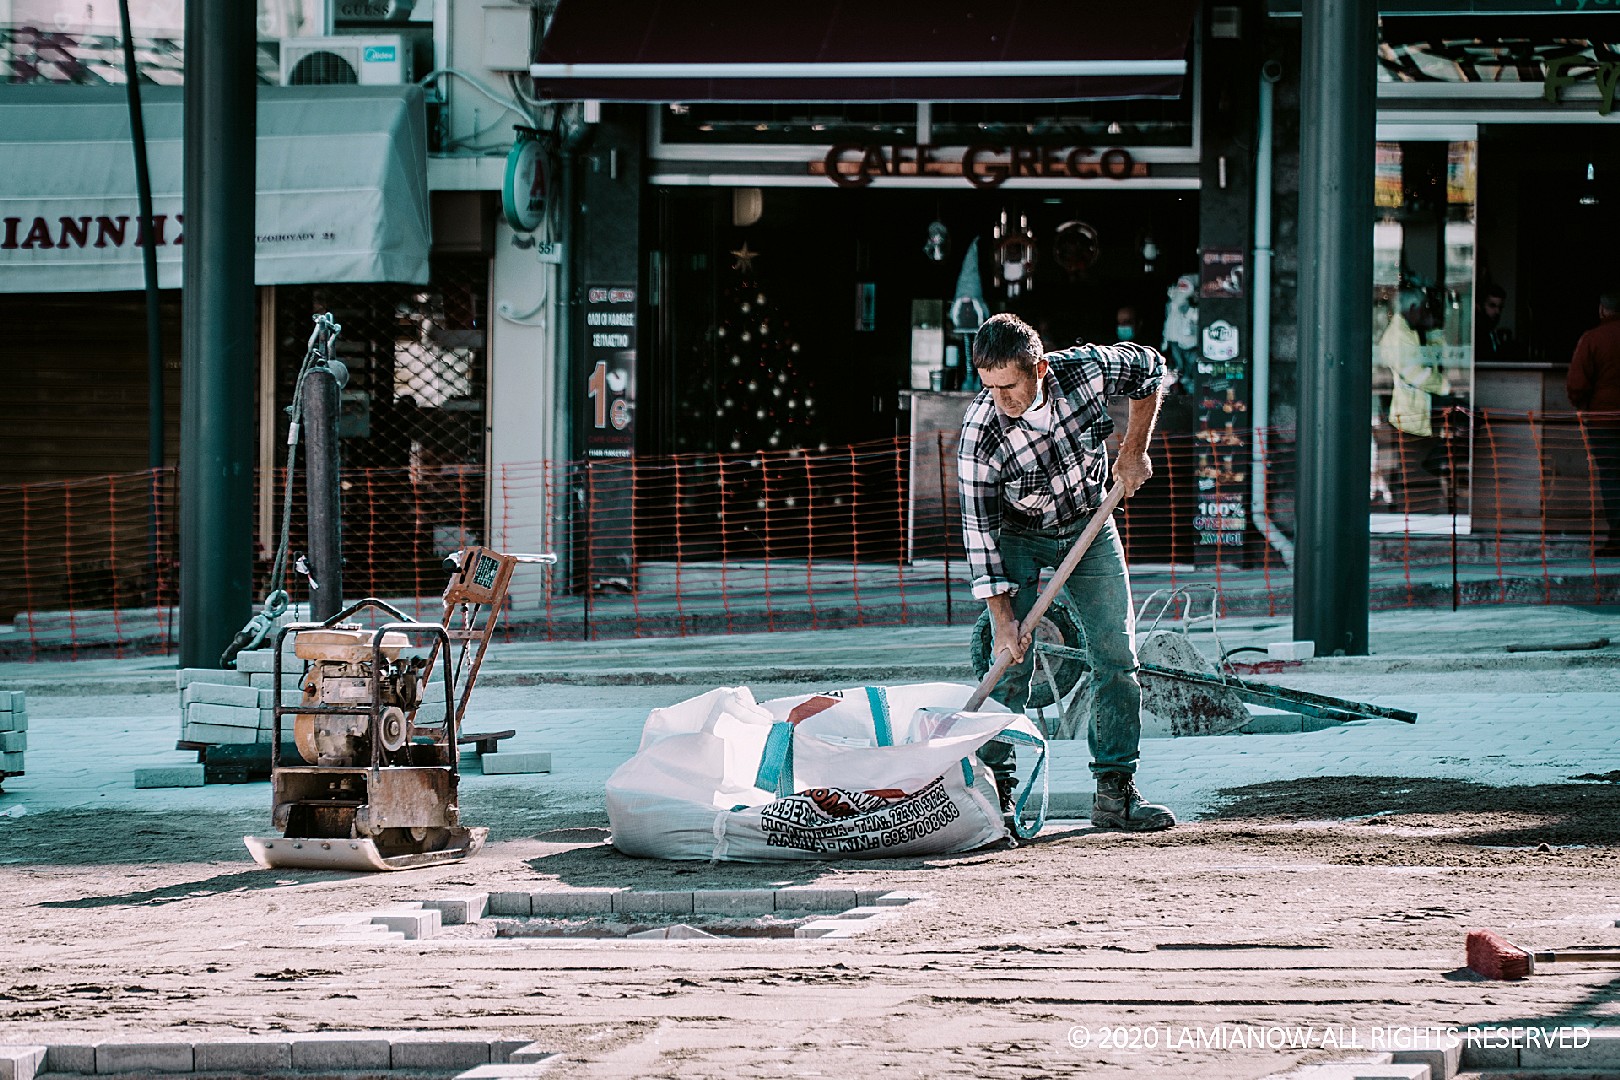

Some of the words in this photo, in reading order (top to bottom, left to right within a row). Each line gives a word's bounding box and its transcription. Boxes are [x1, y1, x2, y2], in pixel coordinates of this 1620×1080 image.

[825, 143, 940, 188] CAFE
[962, 143, 1134, 188] GRECO
[881, 801, 960, 847] 6937008038
